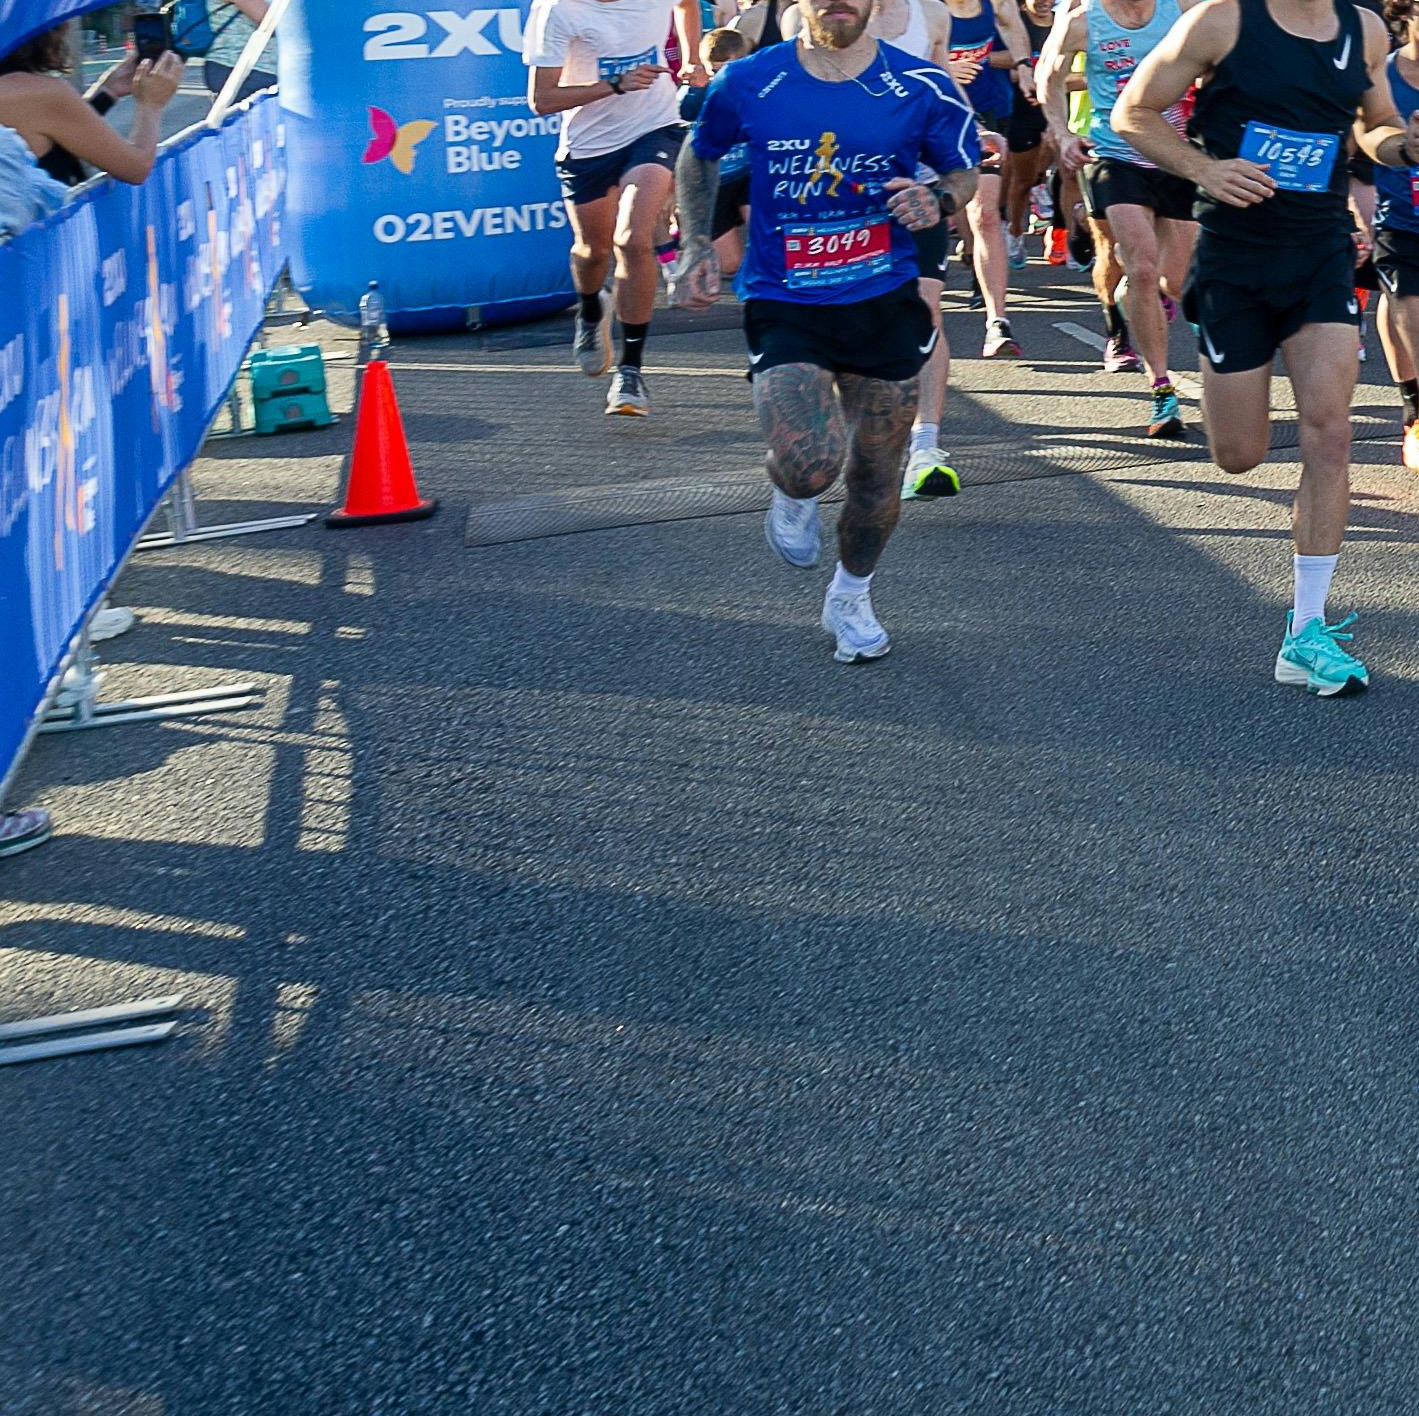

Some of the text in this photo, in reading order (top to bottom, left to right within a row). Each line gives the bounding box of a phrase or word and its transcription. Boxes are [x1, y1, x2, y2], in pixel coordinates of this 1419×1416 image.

[768, 138, 810, 151] 2XU
[1257, 140, 1324, 167] 10543
[447, 146, 522, 174] Blue
[768, 152, 896, 176] WELLNESS
[773, 180, 823, 199] RUN
[373, 200, 567, 244] O2EVENTS
[807, 229, 871, 255] 3049
